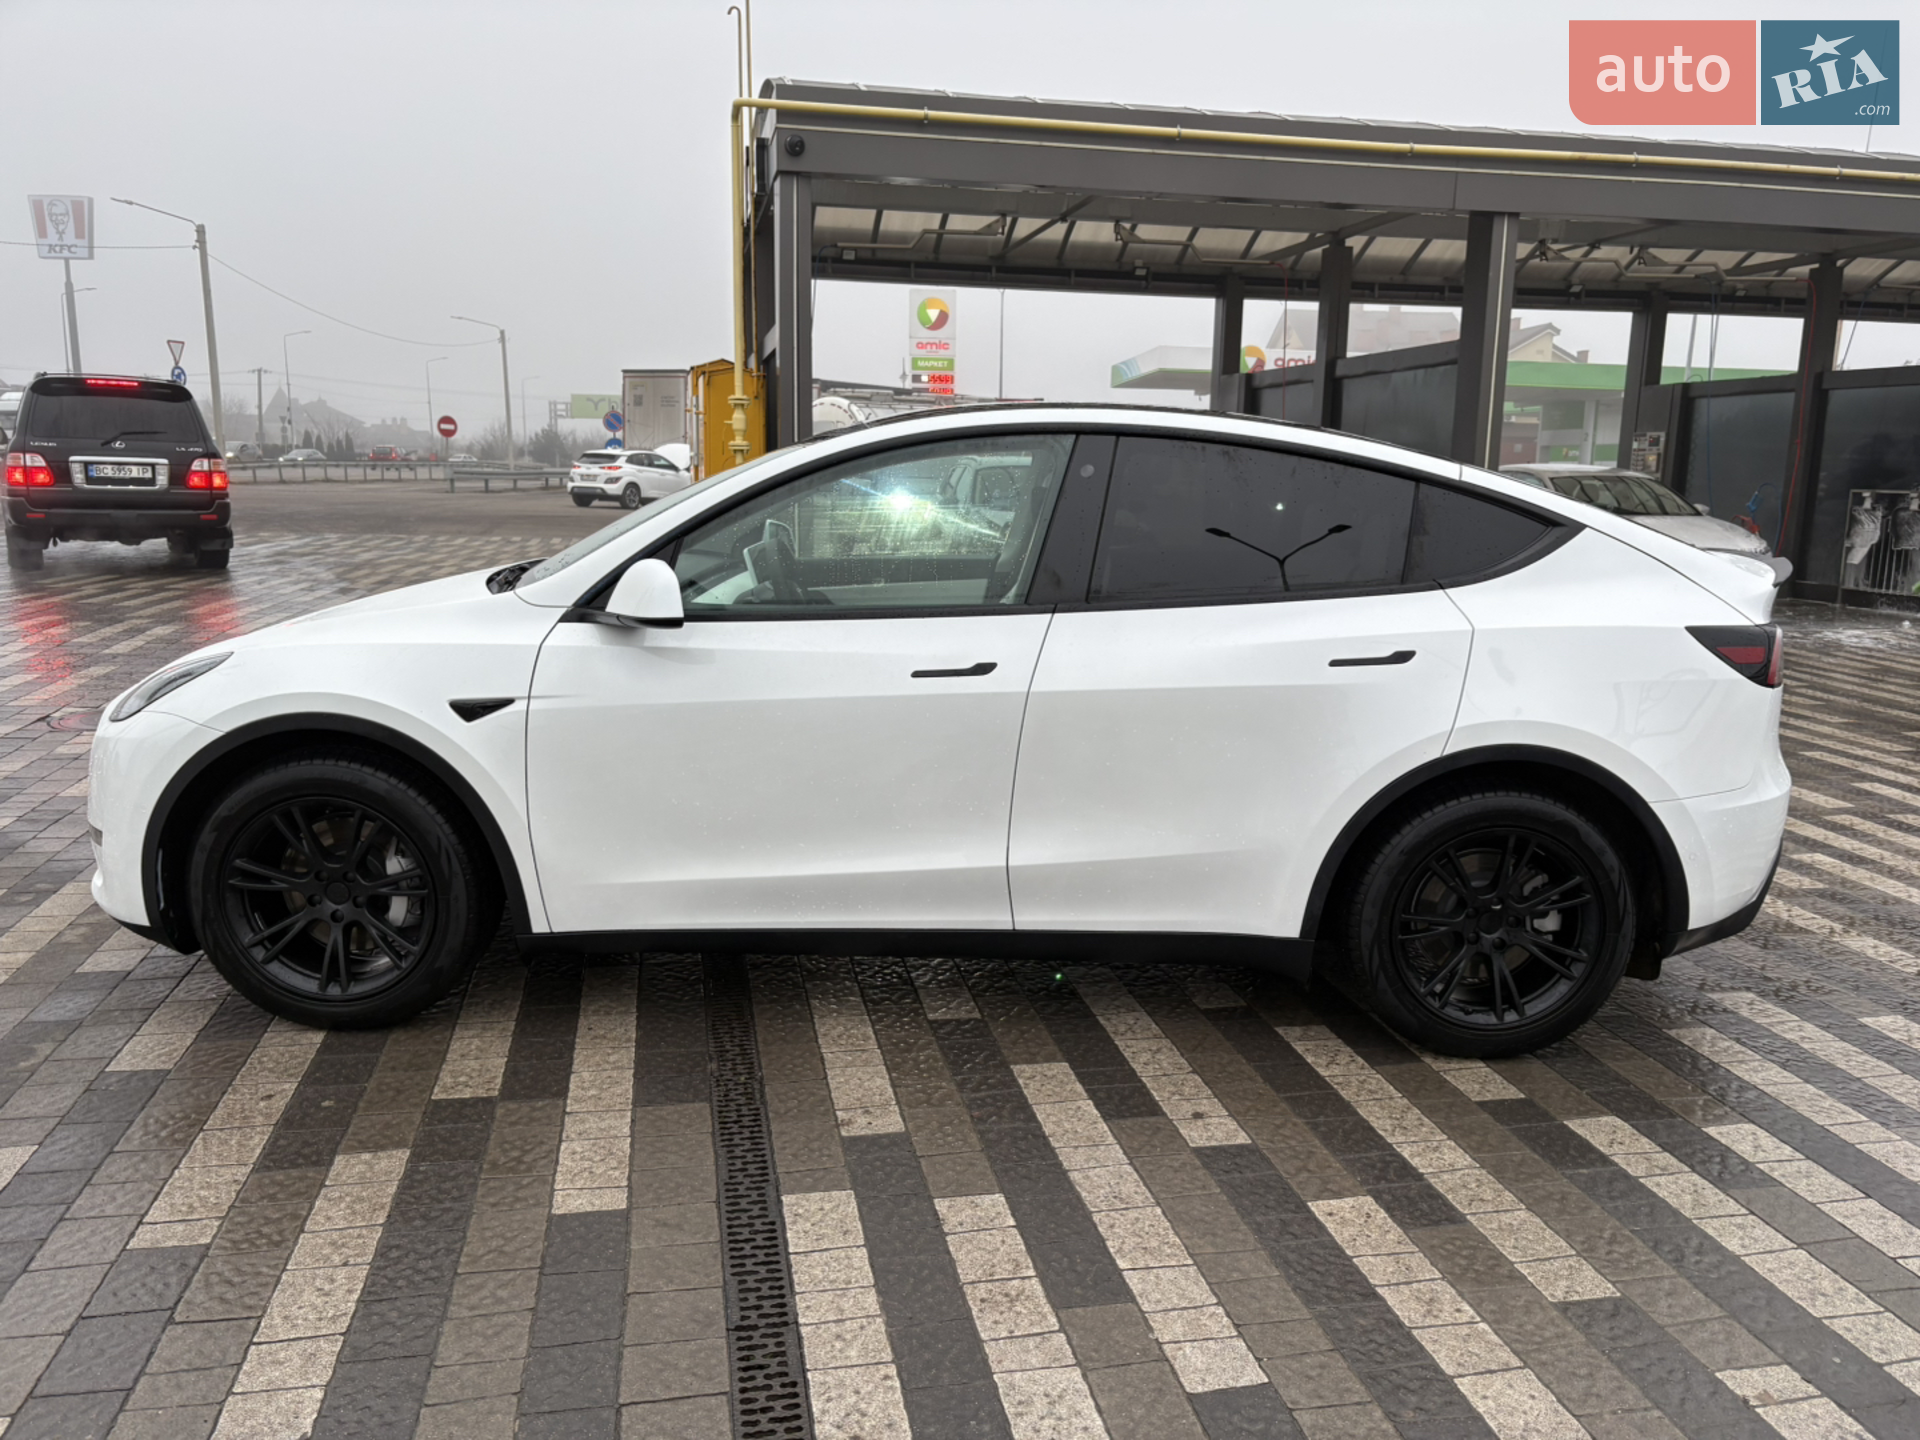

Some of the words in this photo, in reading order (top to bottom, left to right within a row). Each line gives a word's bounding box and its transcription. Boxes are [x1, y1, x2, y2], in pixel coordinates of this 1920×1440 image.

[47, 243, 78, 255] KFC
[916, 340, 951, 351] amic
[1274, 355, 1317, 369] ami
[95, 466, 109, 476] BC
[111, 466, 133, 476] 5959
[136, 467, 149, 477] IP
